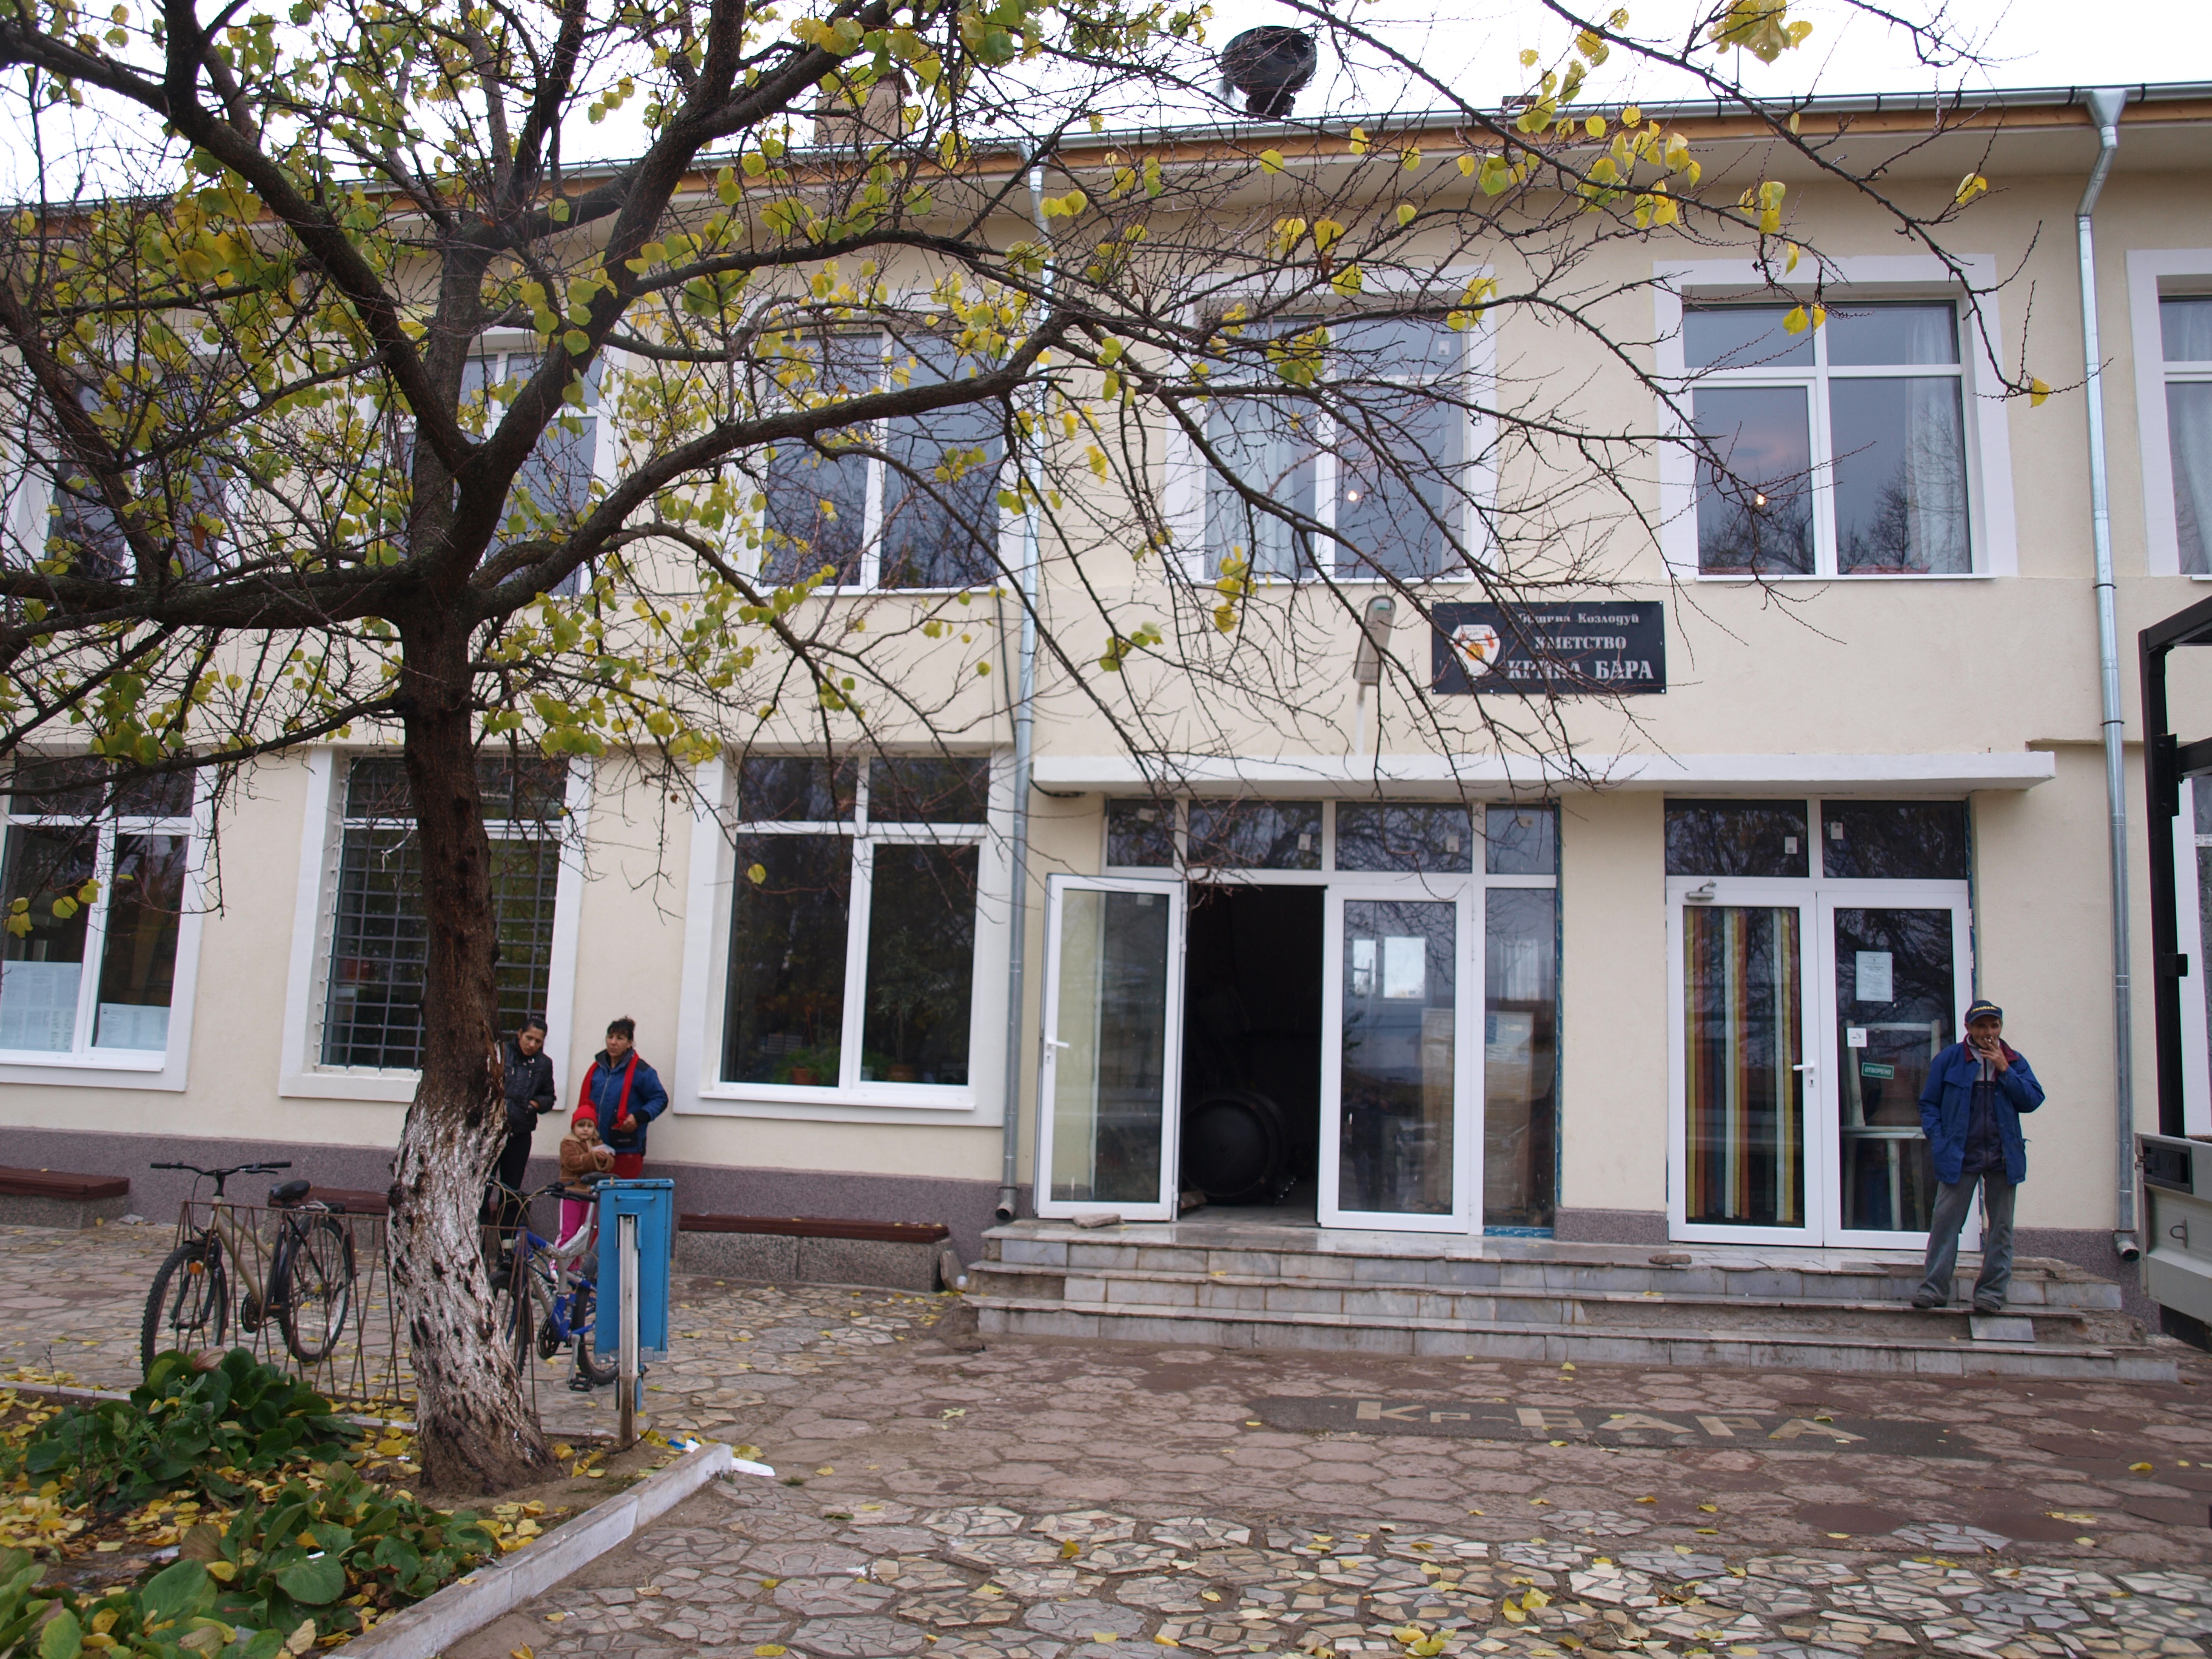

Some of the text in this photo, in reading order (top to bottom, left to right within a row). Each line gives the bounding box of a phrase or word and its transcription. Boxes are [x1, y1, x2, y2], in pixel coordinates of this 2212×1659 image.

[1578, 612, 1640, 626] Козлодуй
[1535, 636, 1627, 649] КМЕТСТВО
[1595, 660, 1654, 679] БАРА
[1865, 1067, 1891, 1075] ОТВОРЕНО
